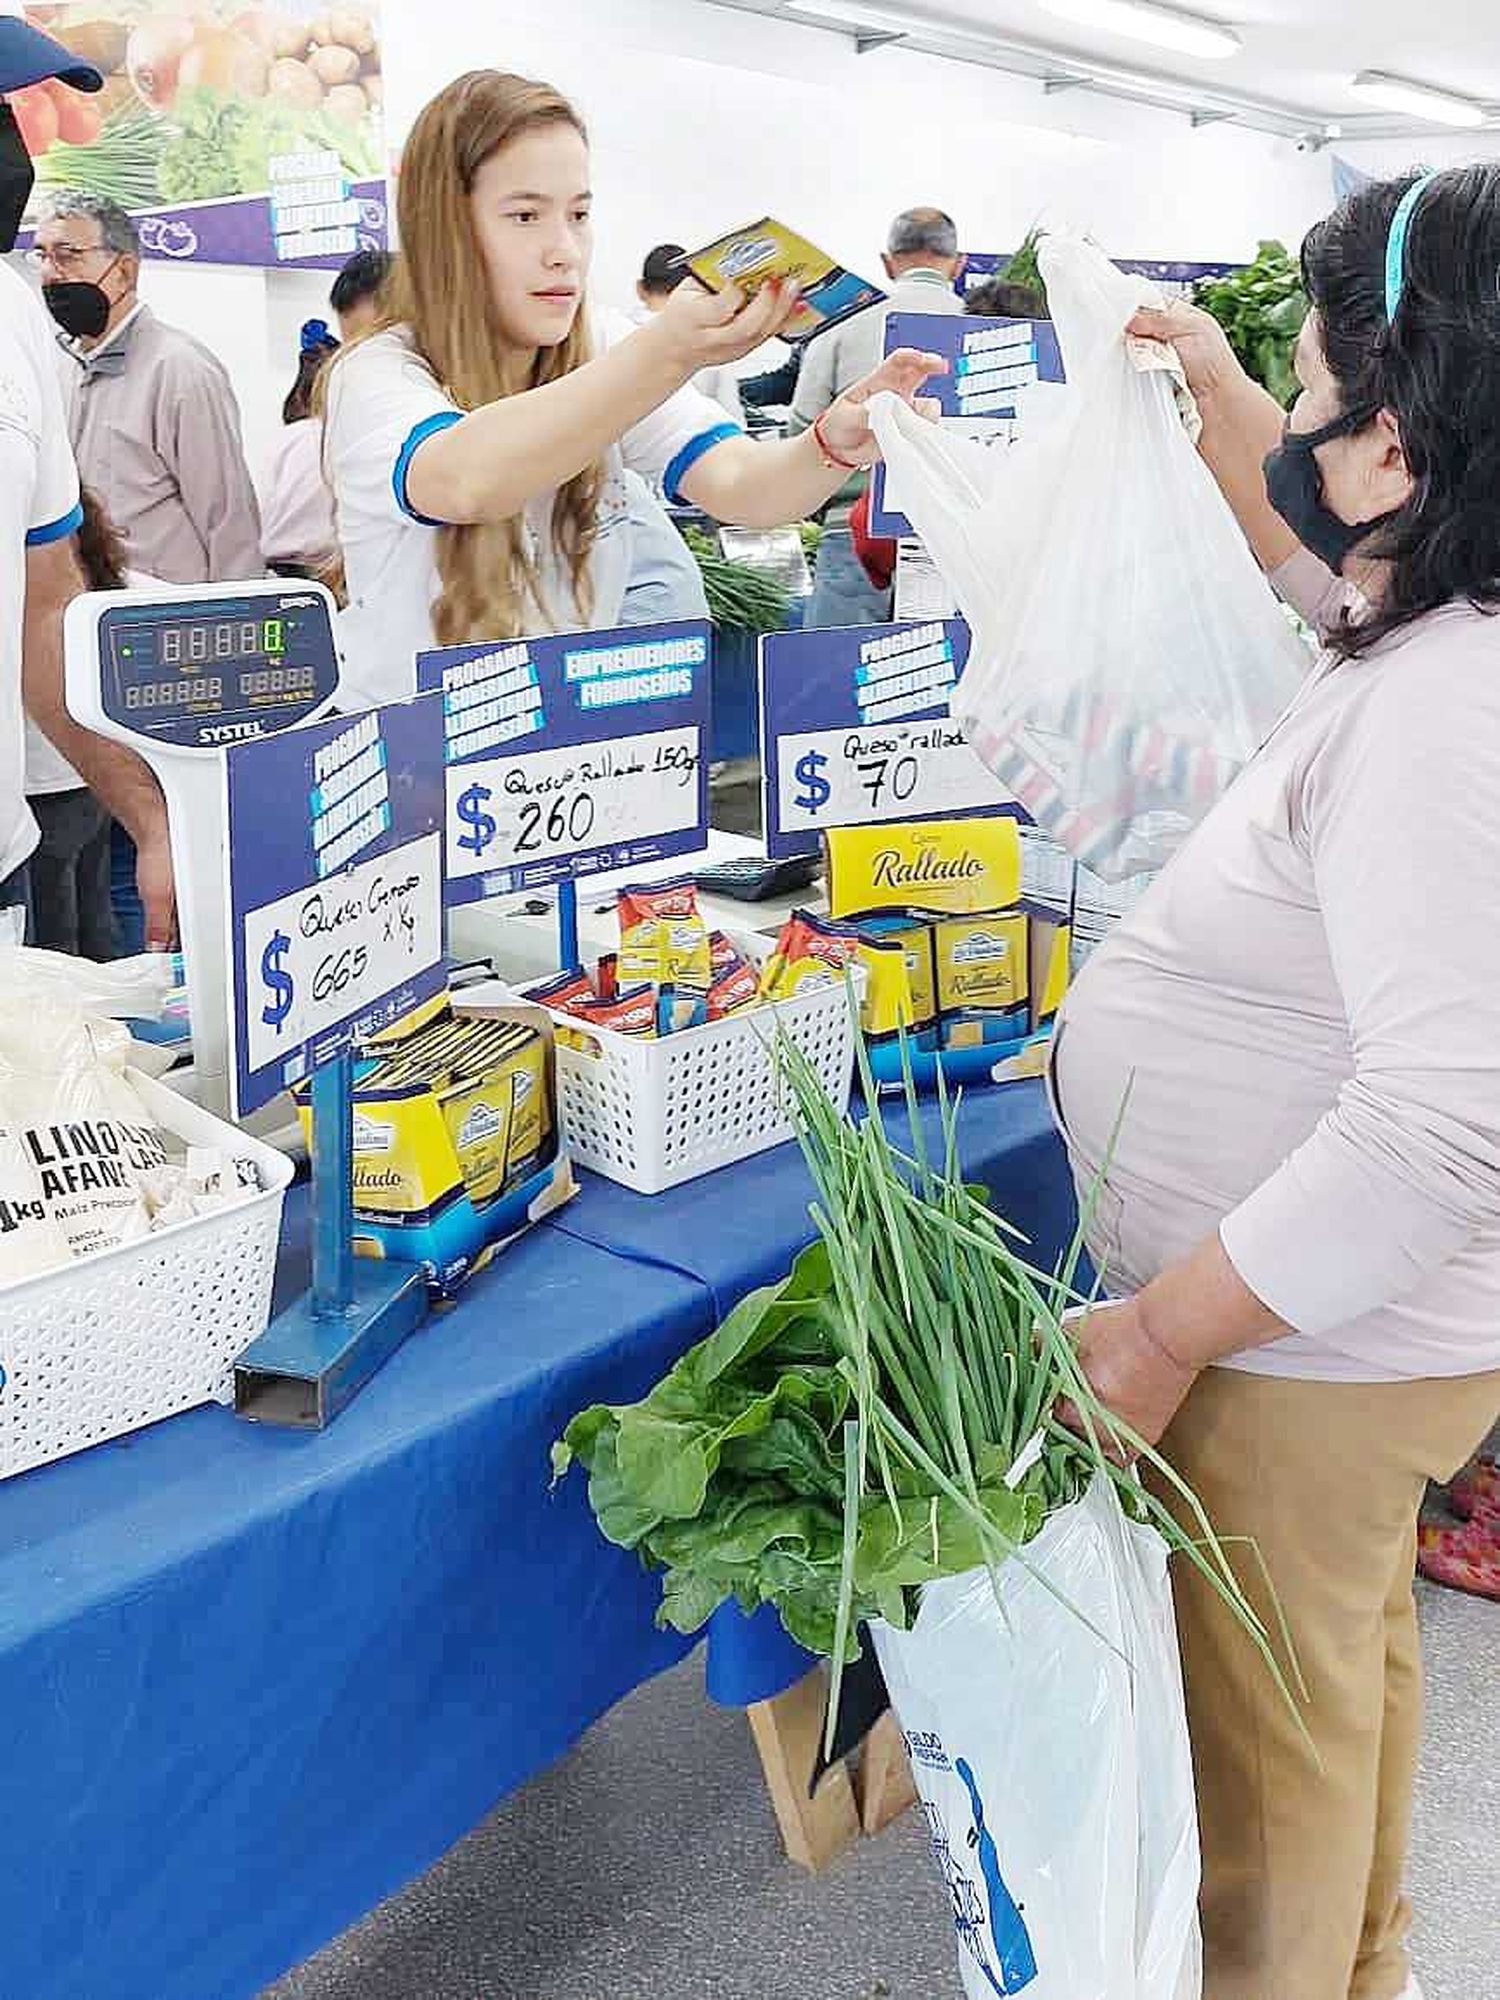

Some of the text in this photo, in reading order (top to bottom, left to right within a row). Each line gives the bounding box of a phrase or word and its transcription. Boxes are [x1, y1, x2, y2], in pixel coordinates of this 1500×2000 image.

[860, 622, 944, 665] PROGRAMA
[443, 643, 529, 694] PROGRAMA
[199, 722, 257, 743] SYSTEL
[314, 711, 380, 787] PROGRAMA
[844, 735, 898, 759] Queso
[794, 750, 918, 815] $ 70
[456, 782, 594, 857] $ 260
[872, 849, 984, 887] Rallado
[262, 929, 294, 1035] $
[313, 945, 368, 1001] 665
[354, 1166, 401, 1188] llado
